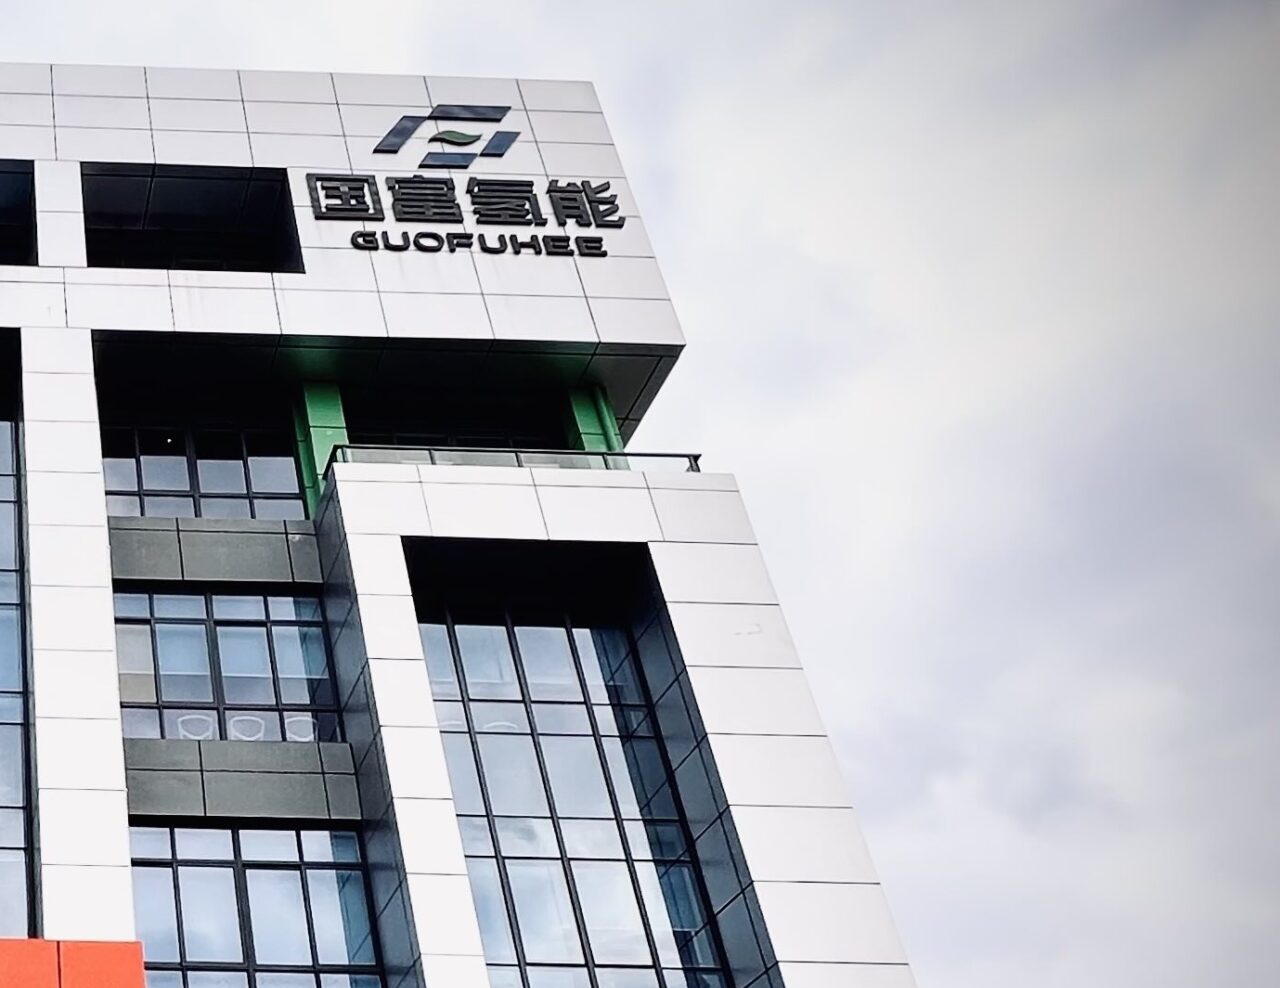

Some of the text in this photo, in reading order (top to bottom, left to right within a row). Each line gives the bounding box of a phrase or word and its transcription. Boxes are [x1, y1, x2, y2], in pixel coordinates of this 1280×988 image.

[306, 173, 625, 229] 国富氢能
[351, 230, 608, 257] GUOFUHEE
